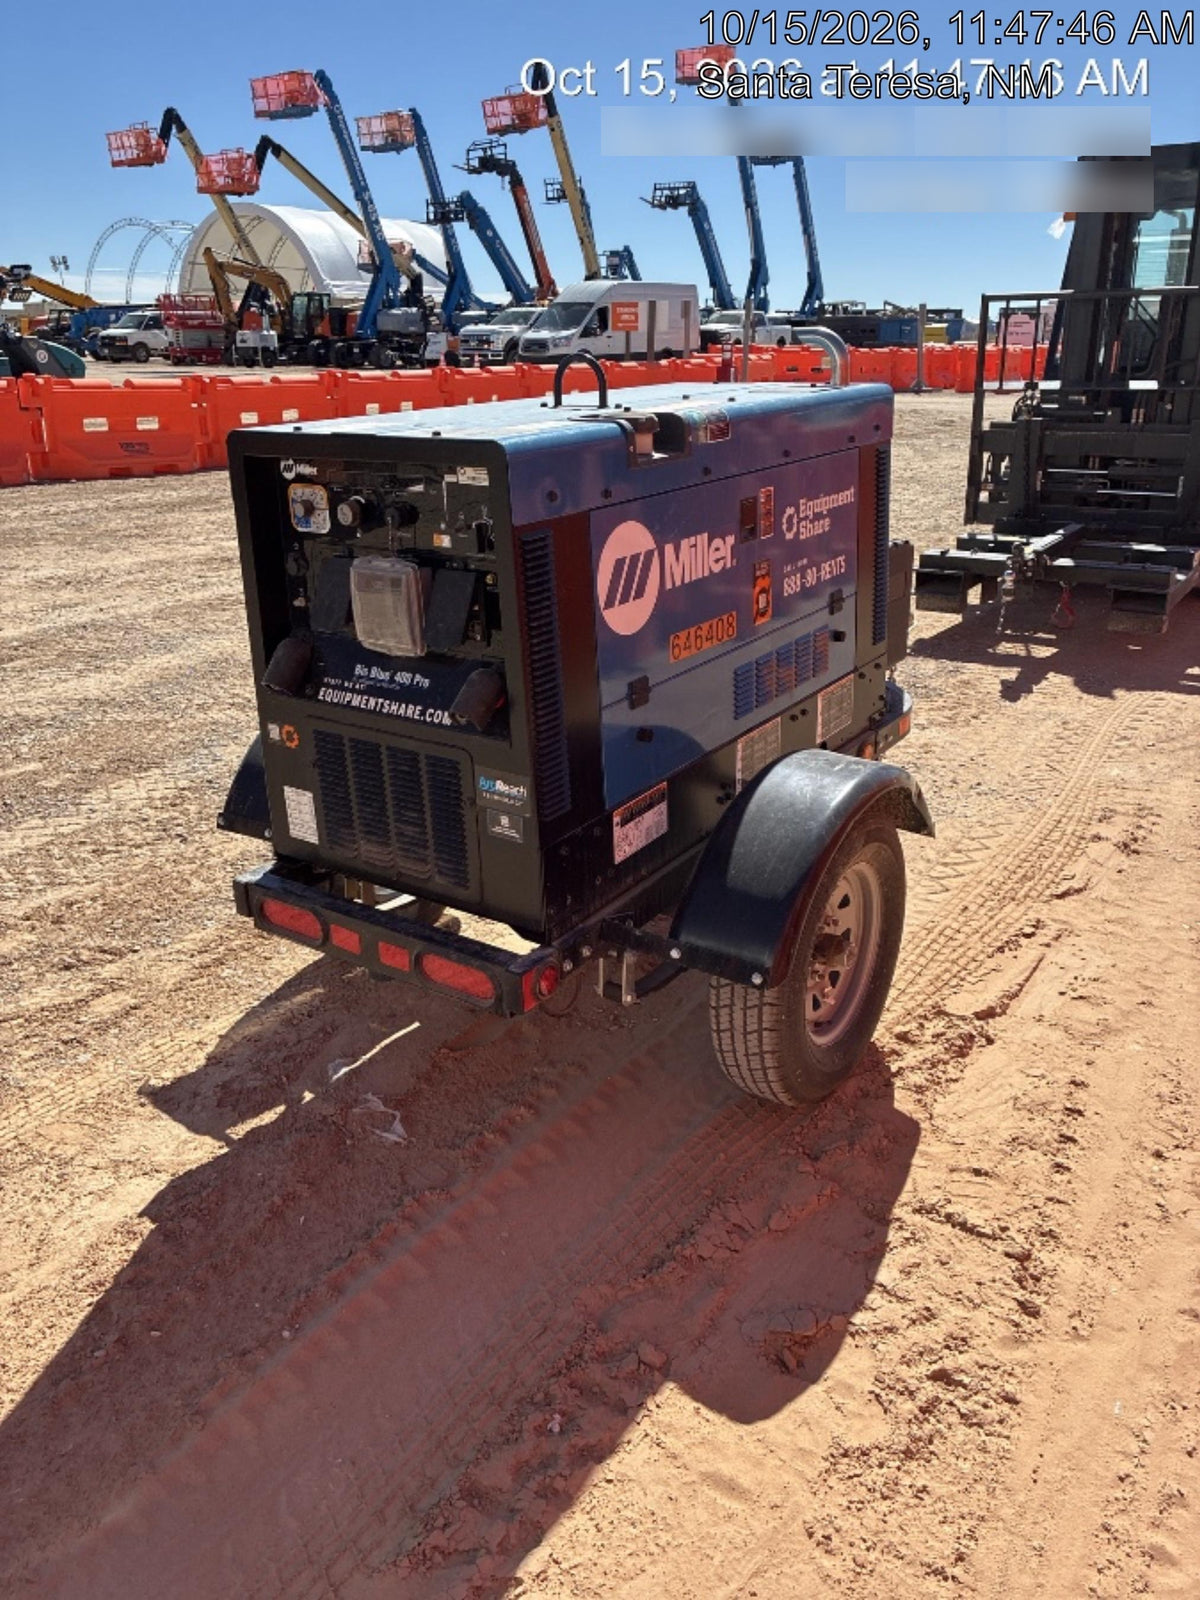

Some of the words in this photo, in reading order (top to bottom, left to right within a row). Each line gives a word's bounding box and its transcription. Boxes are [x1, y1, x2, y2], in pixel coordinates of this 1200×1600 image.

[800, 485, 855, 520] Equipment
[800, 517, 831, 540] Share
[664, 532, 736, 591] Miller
[671, 612, 736, 661] 646408
[317, 686, 453, 726] EQUIPMENTSHARE.COM
